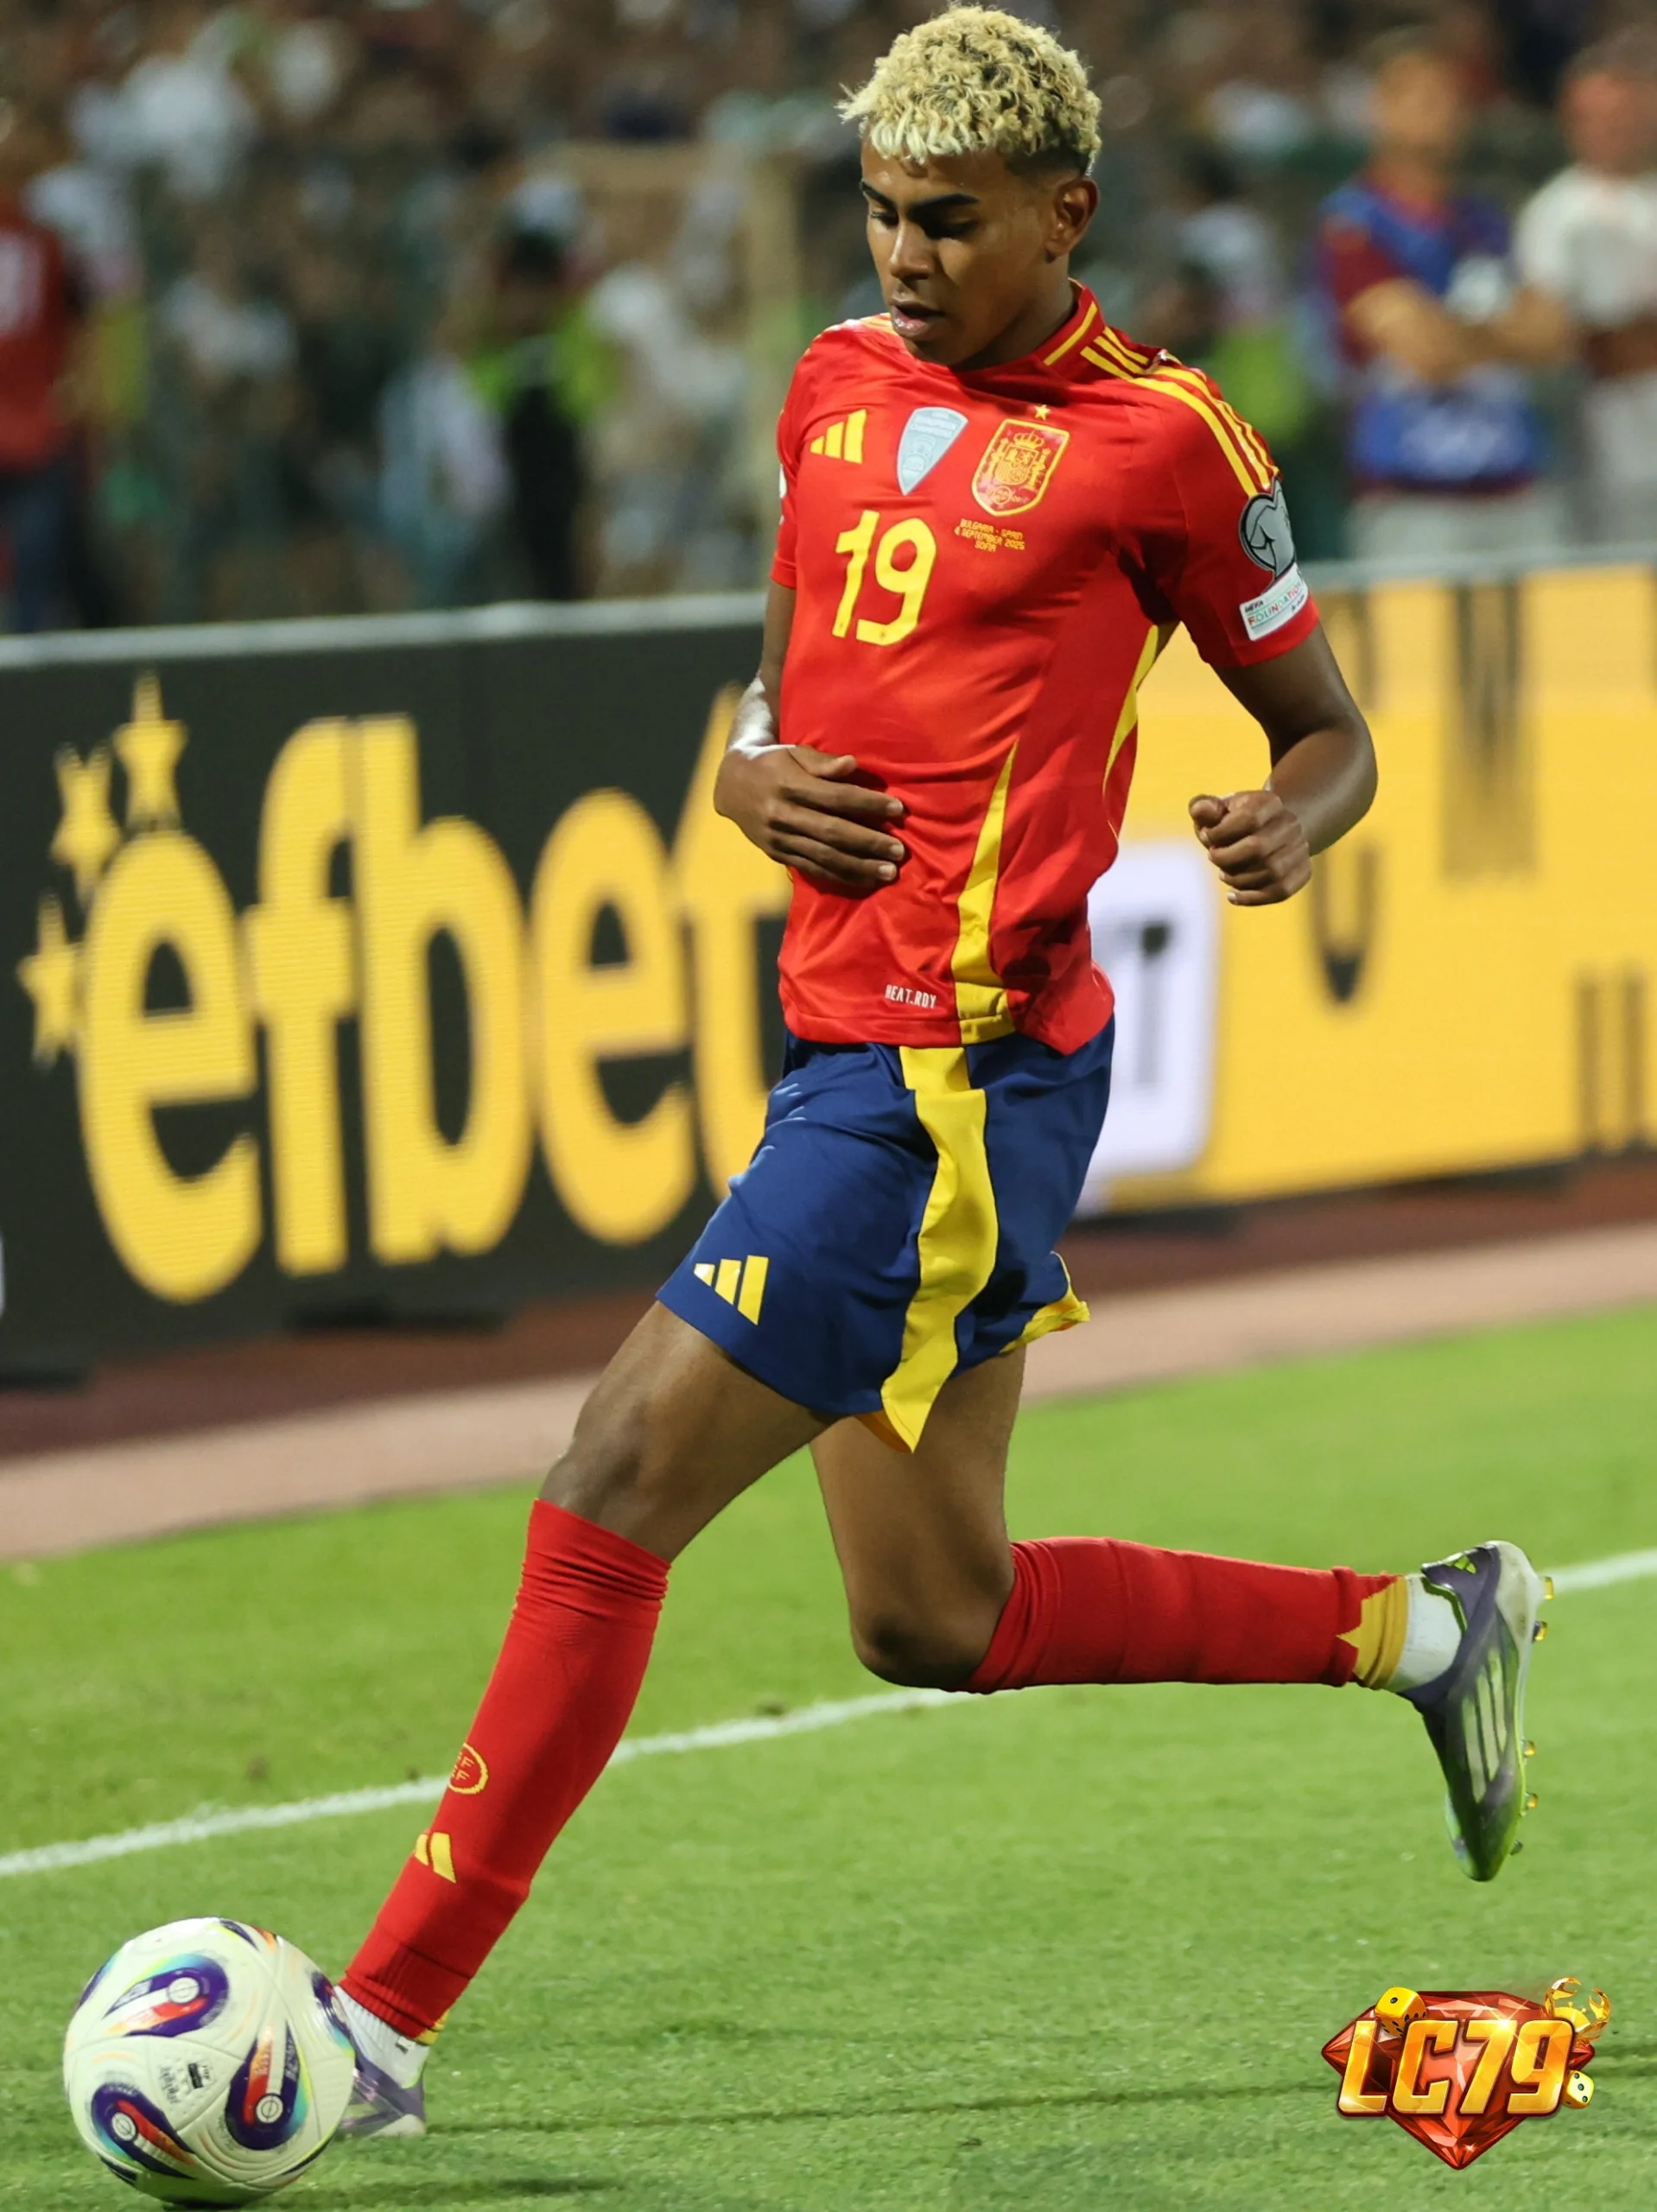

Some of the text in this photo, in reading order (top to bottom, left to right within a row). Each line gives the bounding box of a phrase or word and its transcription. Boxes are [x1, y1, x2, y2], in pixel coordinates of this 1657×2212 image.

[832, 510, 937, 646] 19
[1248, 582, 1303, 626] FOUNDATIO
[76, 683, 790, 1305] efbet
[886, 984, 937, 1009] HEAT.RDY
